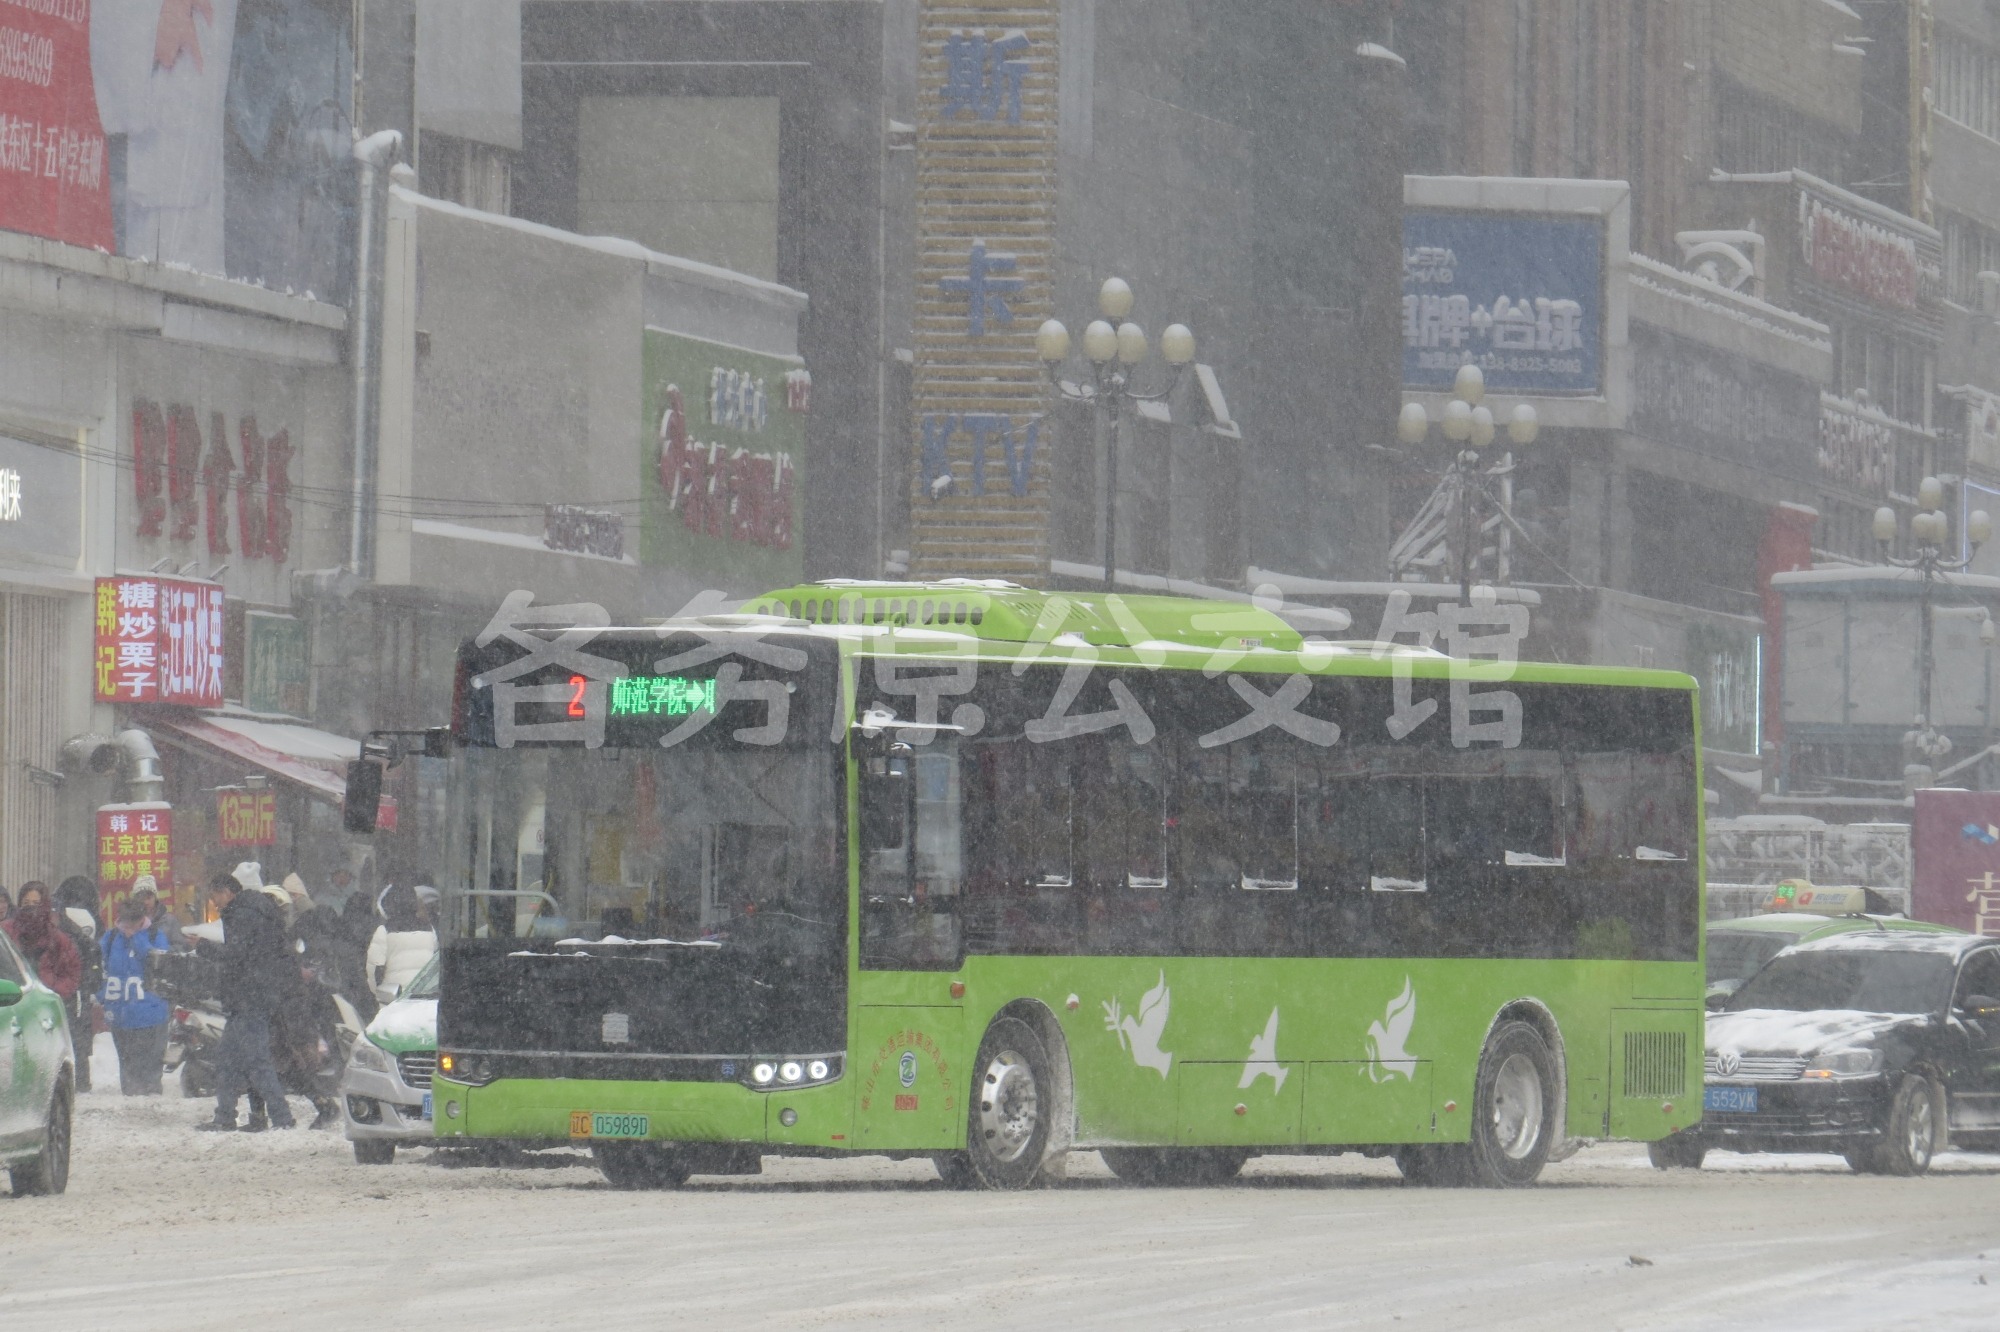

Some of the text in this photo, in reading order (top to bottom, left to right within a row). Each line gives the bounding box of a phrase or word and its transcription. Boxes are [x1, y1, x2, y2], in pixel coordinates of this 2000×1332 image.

[97, 582, 116, 695] 韩记
[118, 582, 157, 697] 糖炒栗子
[169, 587, 222, 700] 迁西炒栗
[568, 676, 585, 717] 2
[611, 677, 687, 716] 师范学院
[110, 814, 159, 832] 韩记
[219, 795, 274, 842] 13元/斤
[101, 835, 170, 856] 正宗迁西
[101, 859, 171, 881] 糖炒栗子
[1704, 1091, 1755, 1110] 552YK
